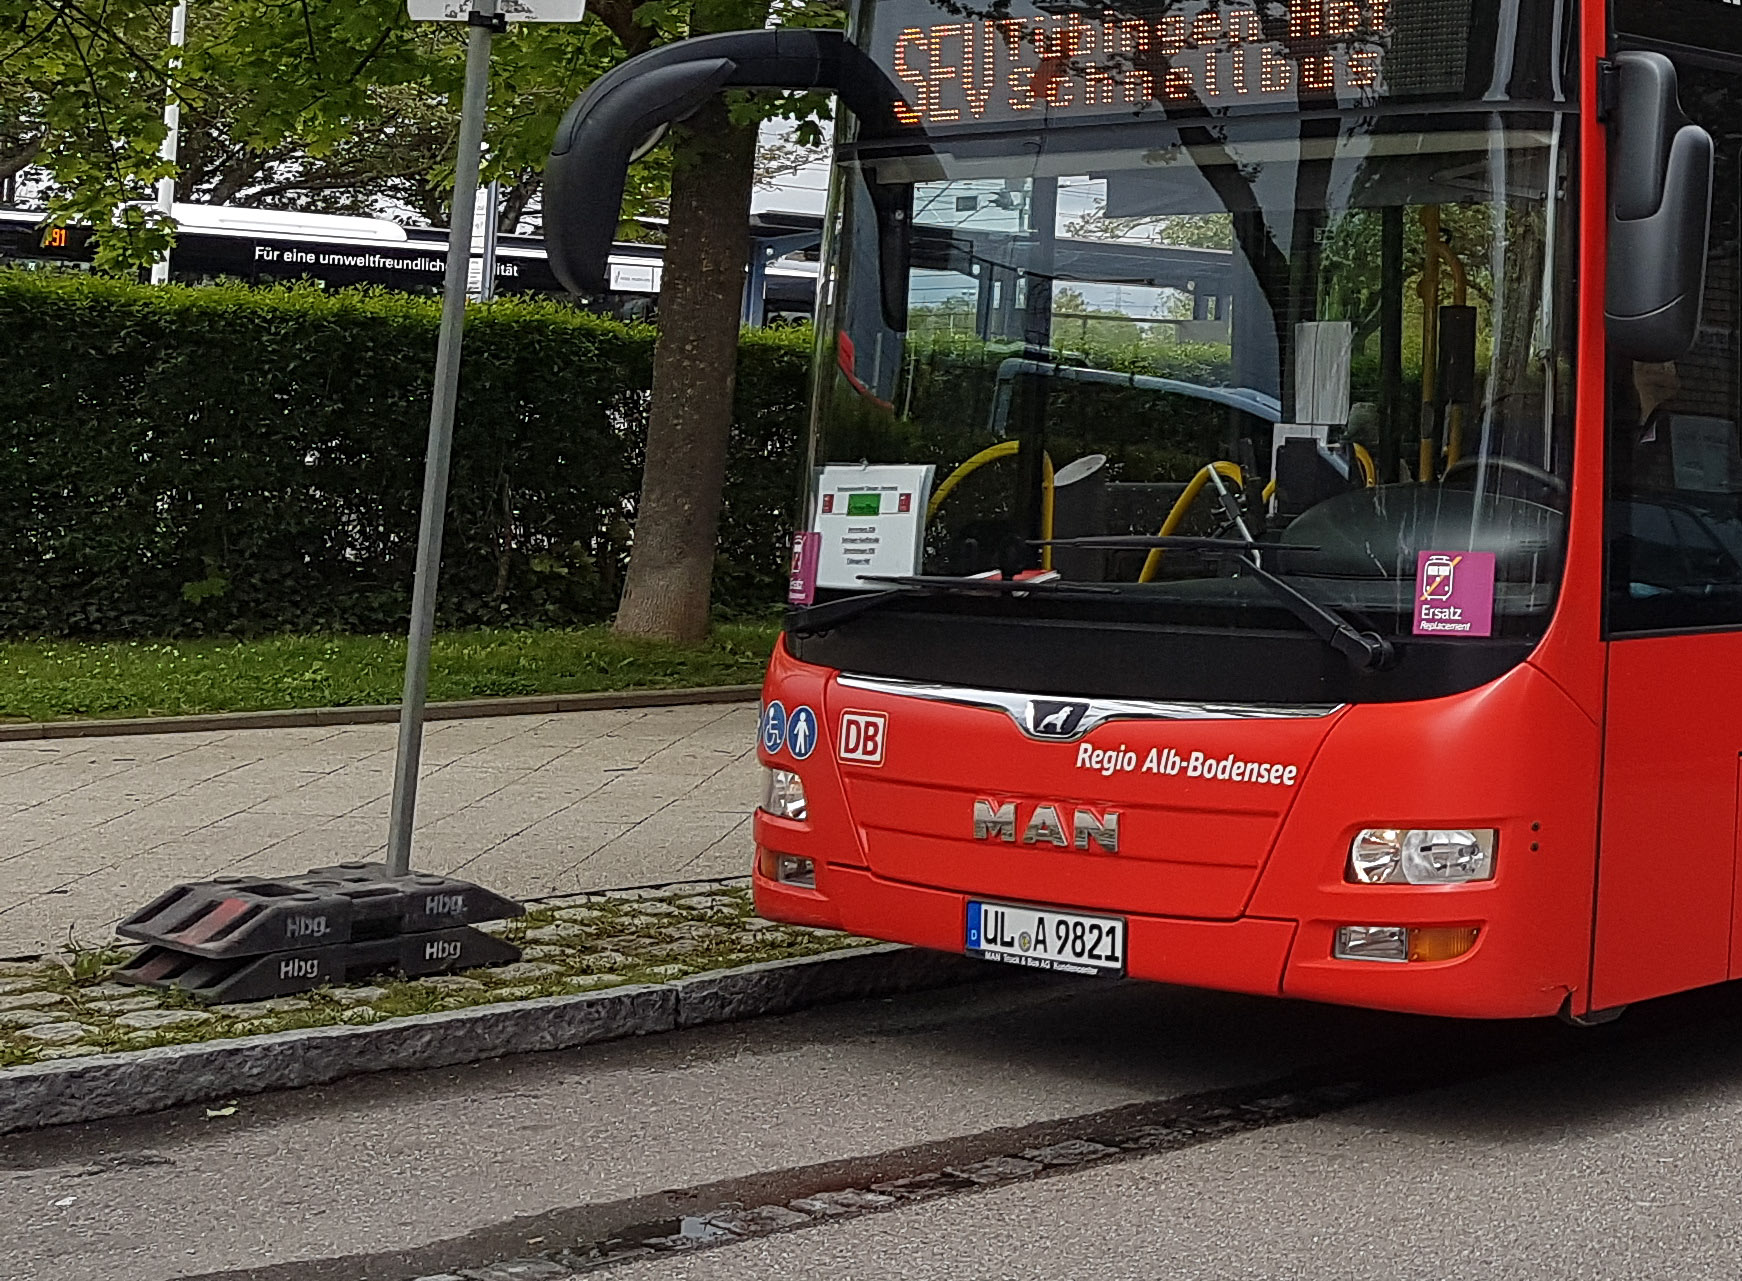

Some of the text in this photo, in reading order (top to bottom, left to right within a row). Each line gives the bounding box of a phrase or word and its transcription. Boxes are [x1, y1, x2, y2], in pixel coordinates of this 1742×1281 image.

[1001, 10, 1260, 62] Tübingen
[894, 21, 994, 124] SEV
[44, 228, 66, 247] 91
[255, 246, 448, 273] Für eine umweltfreundlich
[1421, 604, 1462, 620] Ersatz
[1419, 620, 1471, 631] Replacement
[843, 718, 880, 757] DB
[1076, 742, 1297, 786] Regio Alb-Bodensee
[973, 799, 1118, 853] MAN
[970, 929, 978, 940] D
[983, 908, 1120, 963] UL A 9821
[425, 940, 461, 960] Hbg
[985, 951, 1000, 962] MAN
[279, 959, 318, 980] Hbg
